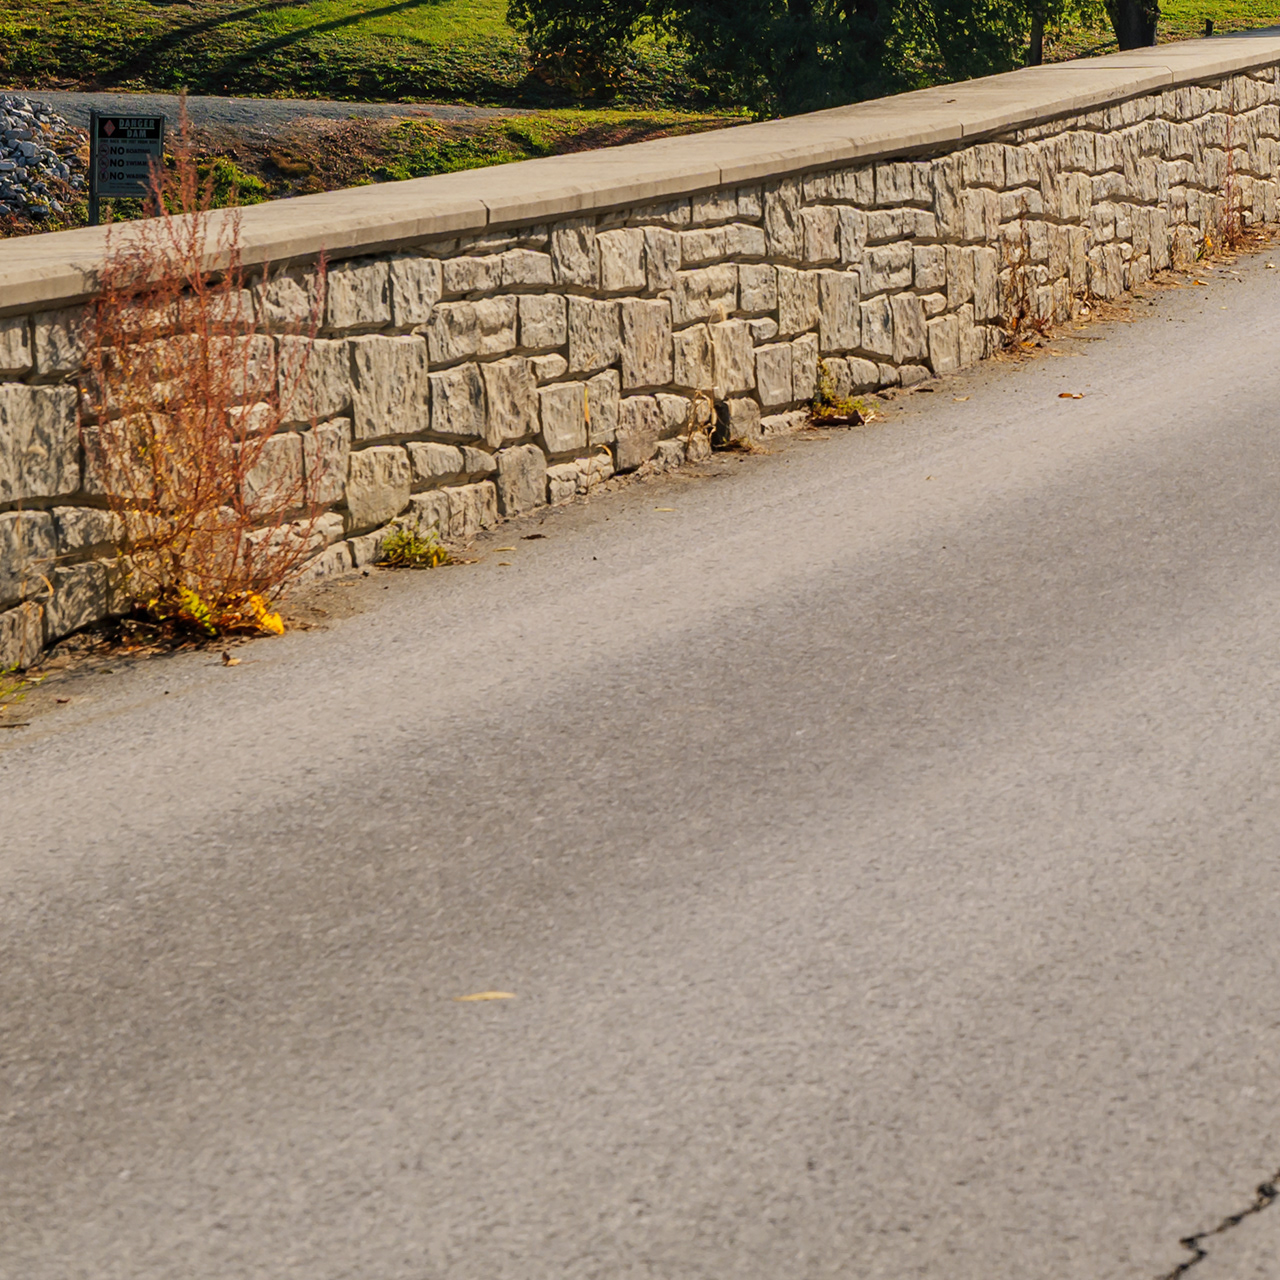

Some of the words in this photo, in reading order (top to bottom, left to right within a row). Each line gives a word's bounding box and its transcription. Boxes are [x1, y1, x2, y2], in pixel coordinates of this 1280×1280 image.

[119, 119, 155, 128] DANGER
[126, 130, 147, 138] DAM
[110, 146, 125, 155] NO
[110, 159, 125, 168] NO
[109, 171, 125, 180] NO
